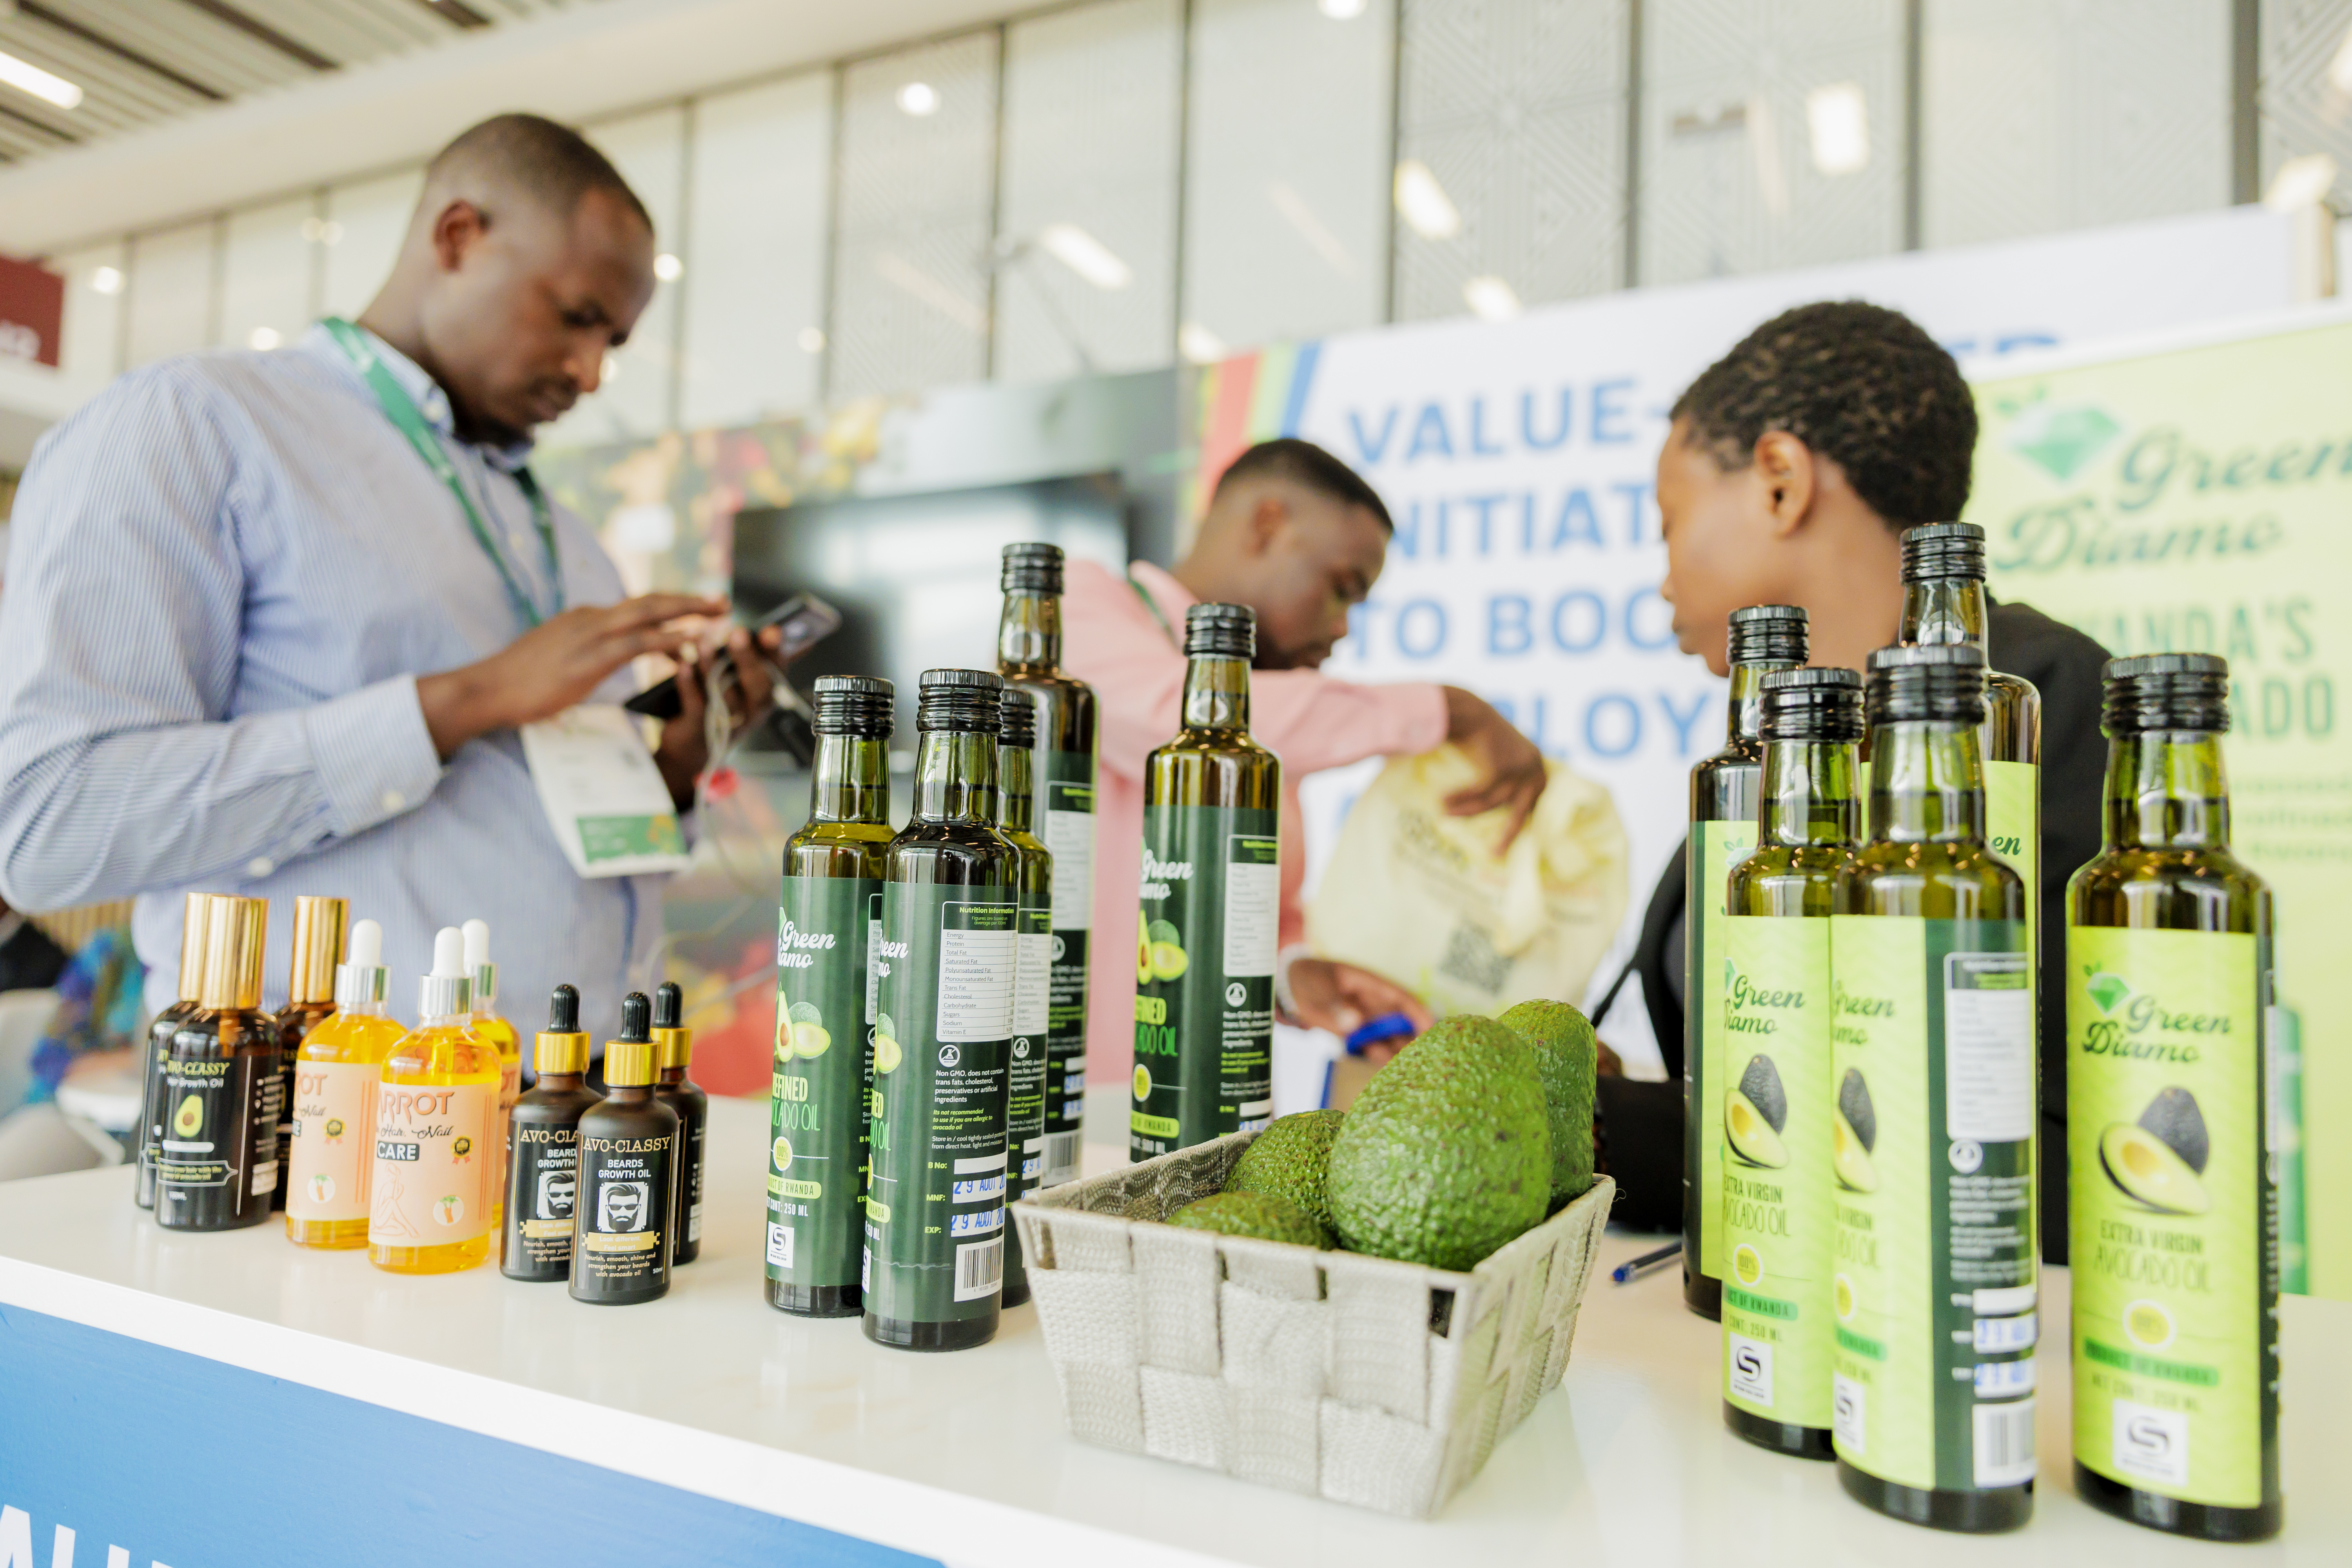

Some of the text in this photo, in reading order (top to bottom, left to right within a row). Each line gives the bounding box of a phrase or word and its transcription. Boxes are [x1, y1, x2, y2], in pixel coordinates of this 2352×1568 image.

[782, 920, 836, 951] Green
[1733, 975, 1806, 1010] Green
[2125, 995, 2232, 1035] Green
[2082, 1020, 2201, 1063] Diamo
[209, 1078, 224, 1089] Oil
[934, 1096, 967, 1104] ingredients
[801, 1103, 820, 1131] OIL
[412, 1125, 454, 1139] Nail
[377, 1141, 417, 1161] CARE
[547, 1148, 577, 1158] BEARD
[777, 1145, 788, 1158] 100%
[537, 1158, 575, 1168] GROWTH
[607, 1159, 644, 1168] BEARDS
[598, 1169, 652, 1179] GROWTH OIL
[778, 1180, 814, 1195] OF RWANDA
[1746, 1180, 1782, 1203] VIRGIN
[770, 1198, 808, 1217] CONT: 250 ML
[2101, 1220, 2204, 1254] EXTRA VIRGIN
[584, 1254, 606, 1262] Nourish,
